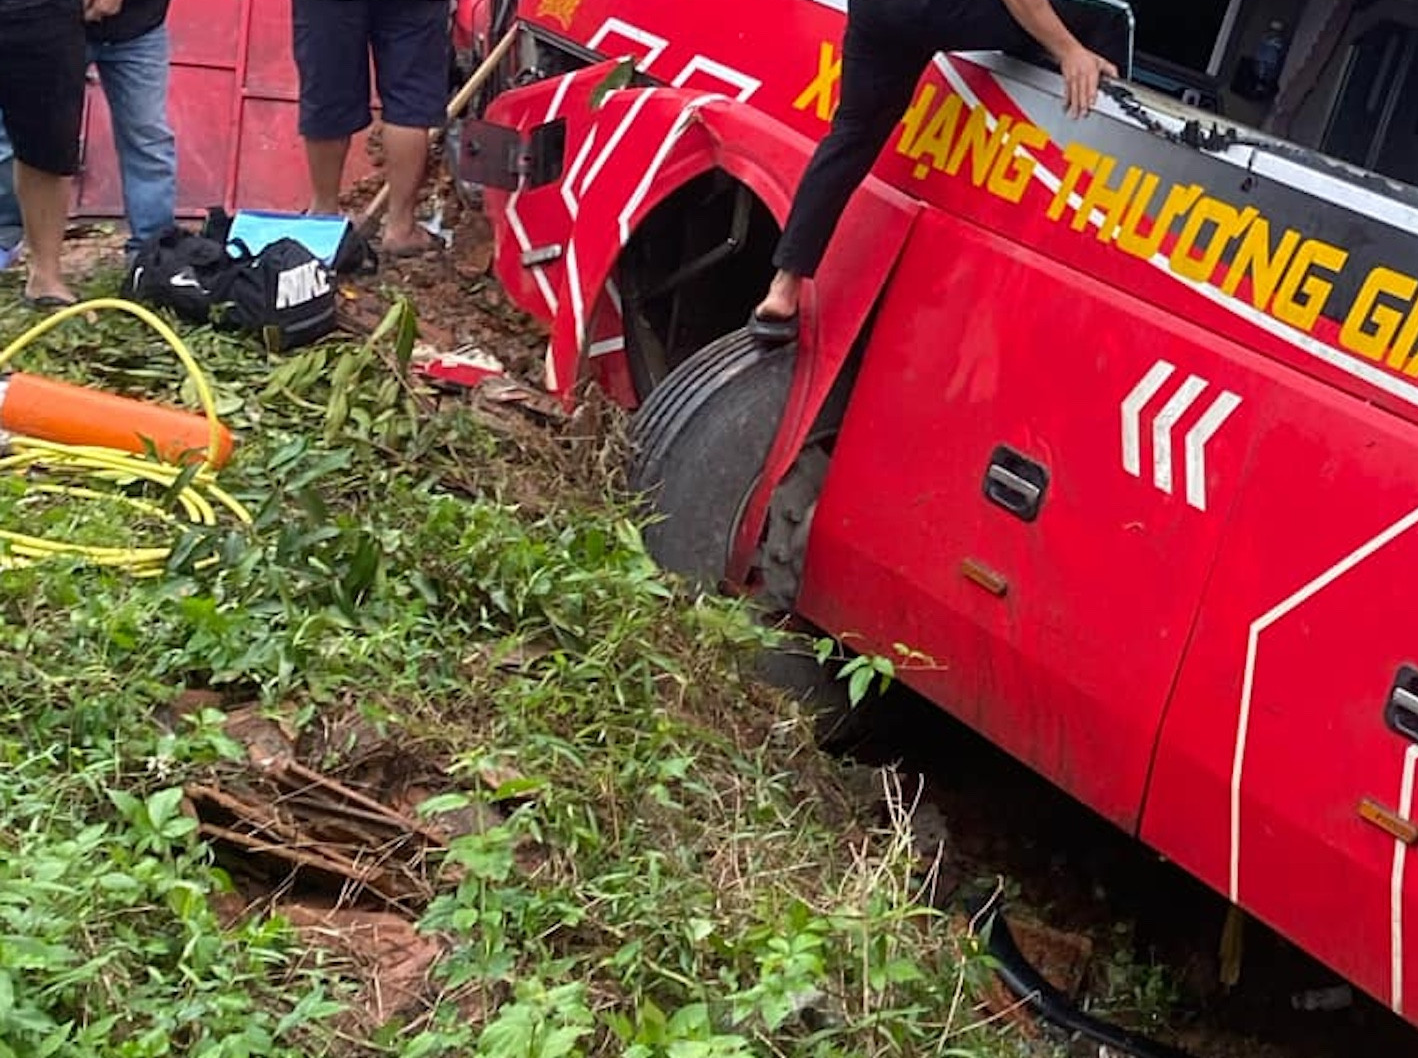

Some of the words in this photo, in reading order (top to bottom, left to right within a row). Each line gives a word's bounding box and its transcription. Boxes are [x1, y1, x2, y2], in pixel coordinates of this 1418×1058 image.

[792, 41, 842, 122] X
[1046, 144, 1349, 331] THƯƠNG
[276, 260, 331, 310] NIKE
